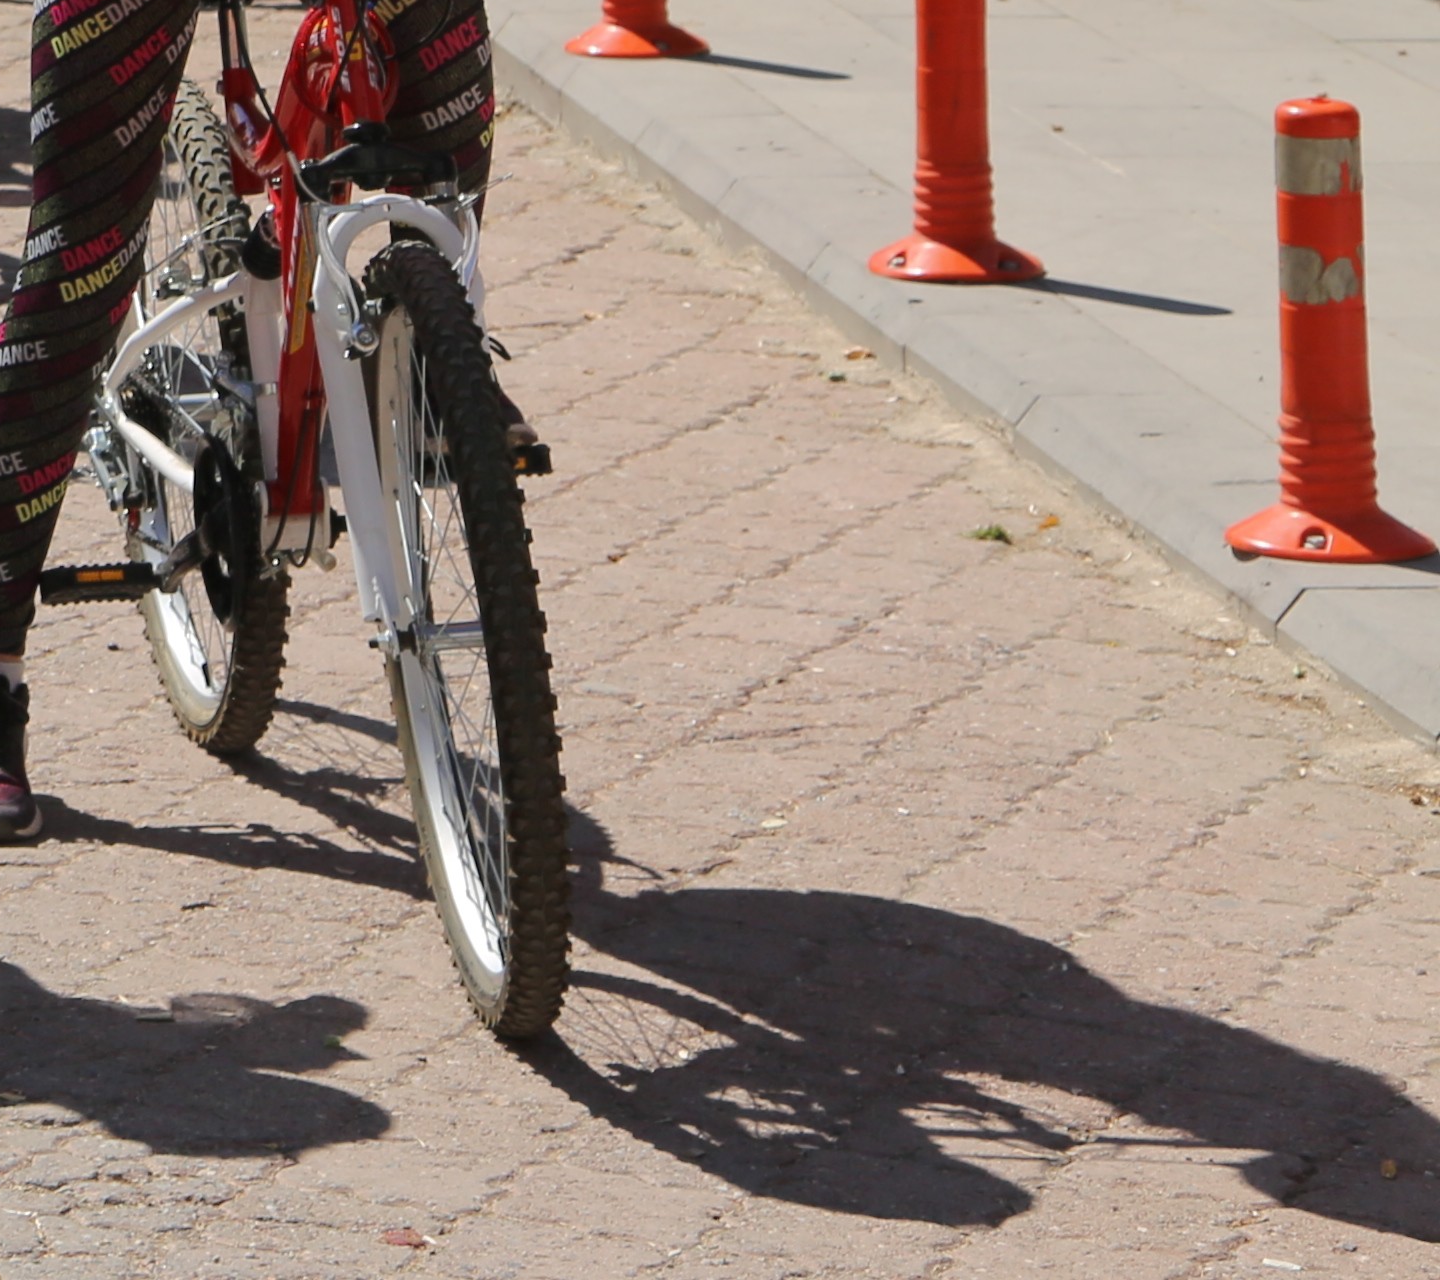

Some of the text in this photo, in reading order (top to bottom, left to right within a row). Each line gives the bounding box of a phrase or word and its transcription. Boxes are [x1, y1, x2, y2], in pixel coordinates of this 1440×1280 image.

[51, 10, 115, 59] DANCE
[109, 24, 172, 86] DANCE
[418, 16, 482, 73] DANCE
[113, 83, 168, 147] DANCE
[421, 83, 485, 131] DANCE
[26, 224, 68, 260] DANCE
[60, 225, 124, 273] DANCE
[59, 257, 122, 303] DANCE
